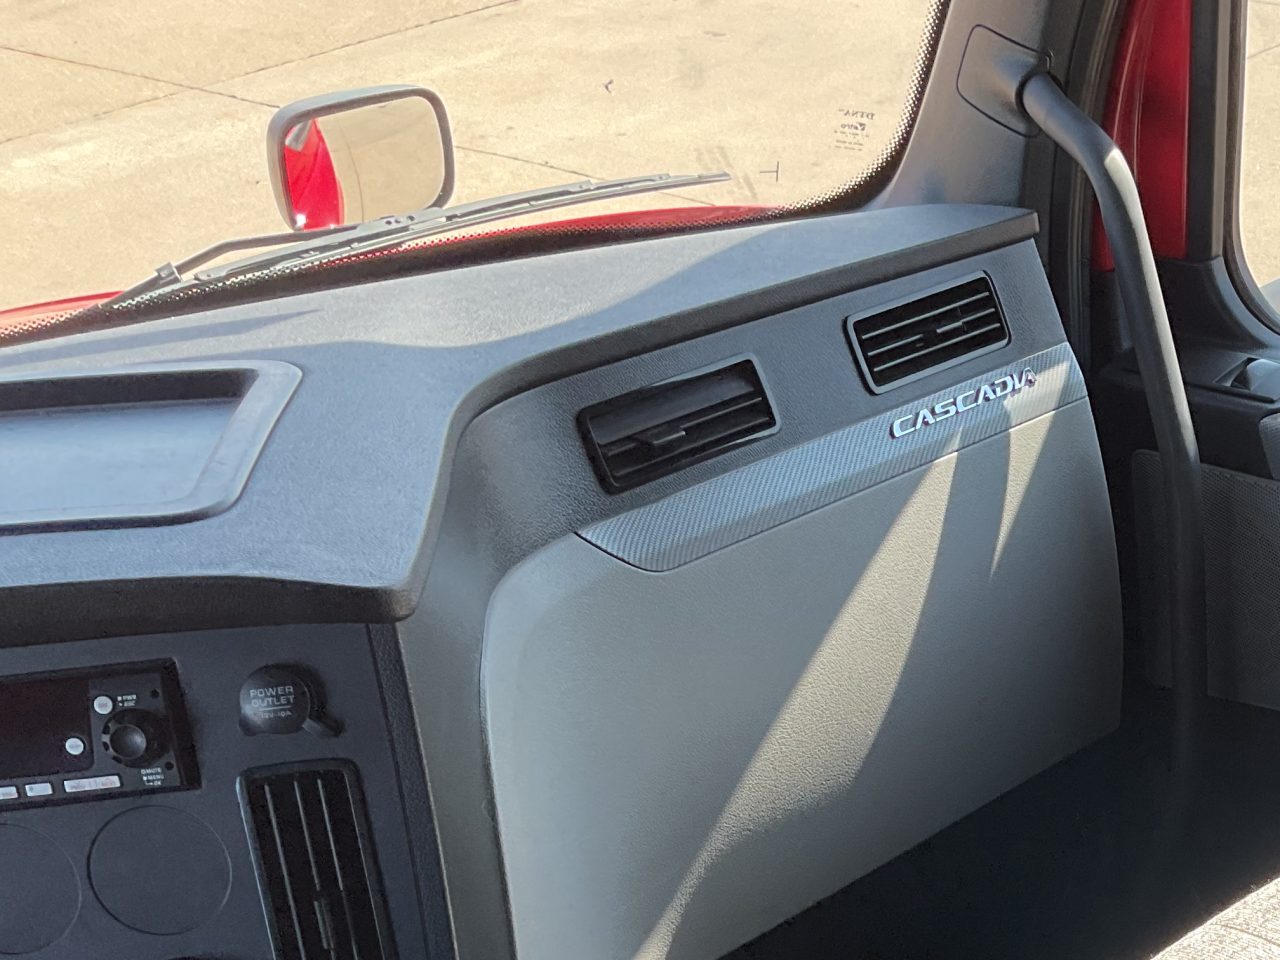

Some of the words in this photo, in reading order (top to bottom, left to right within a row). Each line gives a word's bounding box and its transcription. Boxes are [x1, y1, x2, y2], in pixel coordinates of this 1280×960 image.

[890, 367, 1037, 438] CASCADIA
[249, 685, 294, 698] POWER
[251, 695, 295, 708] OUTLET
